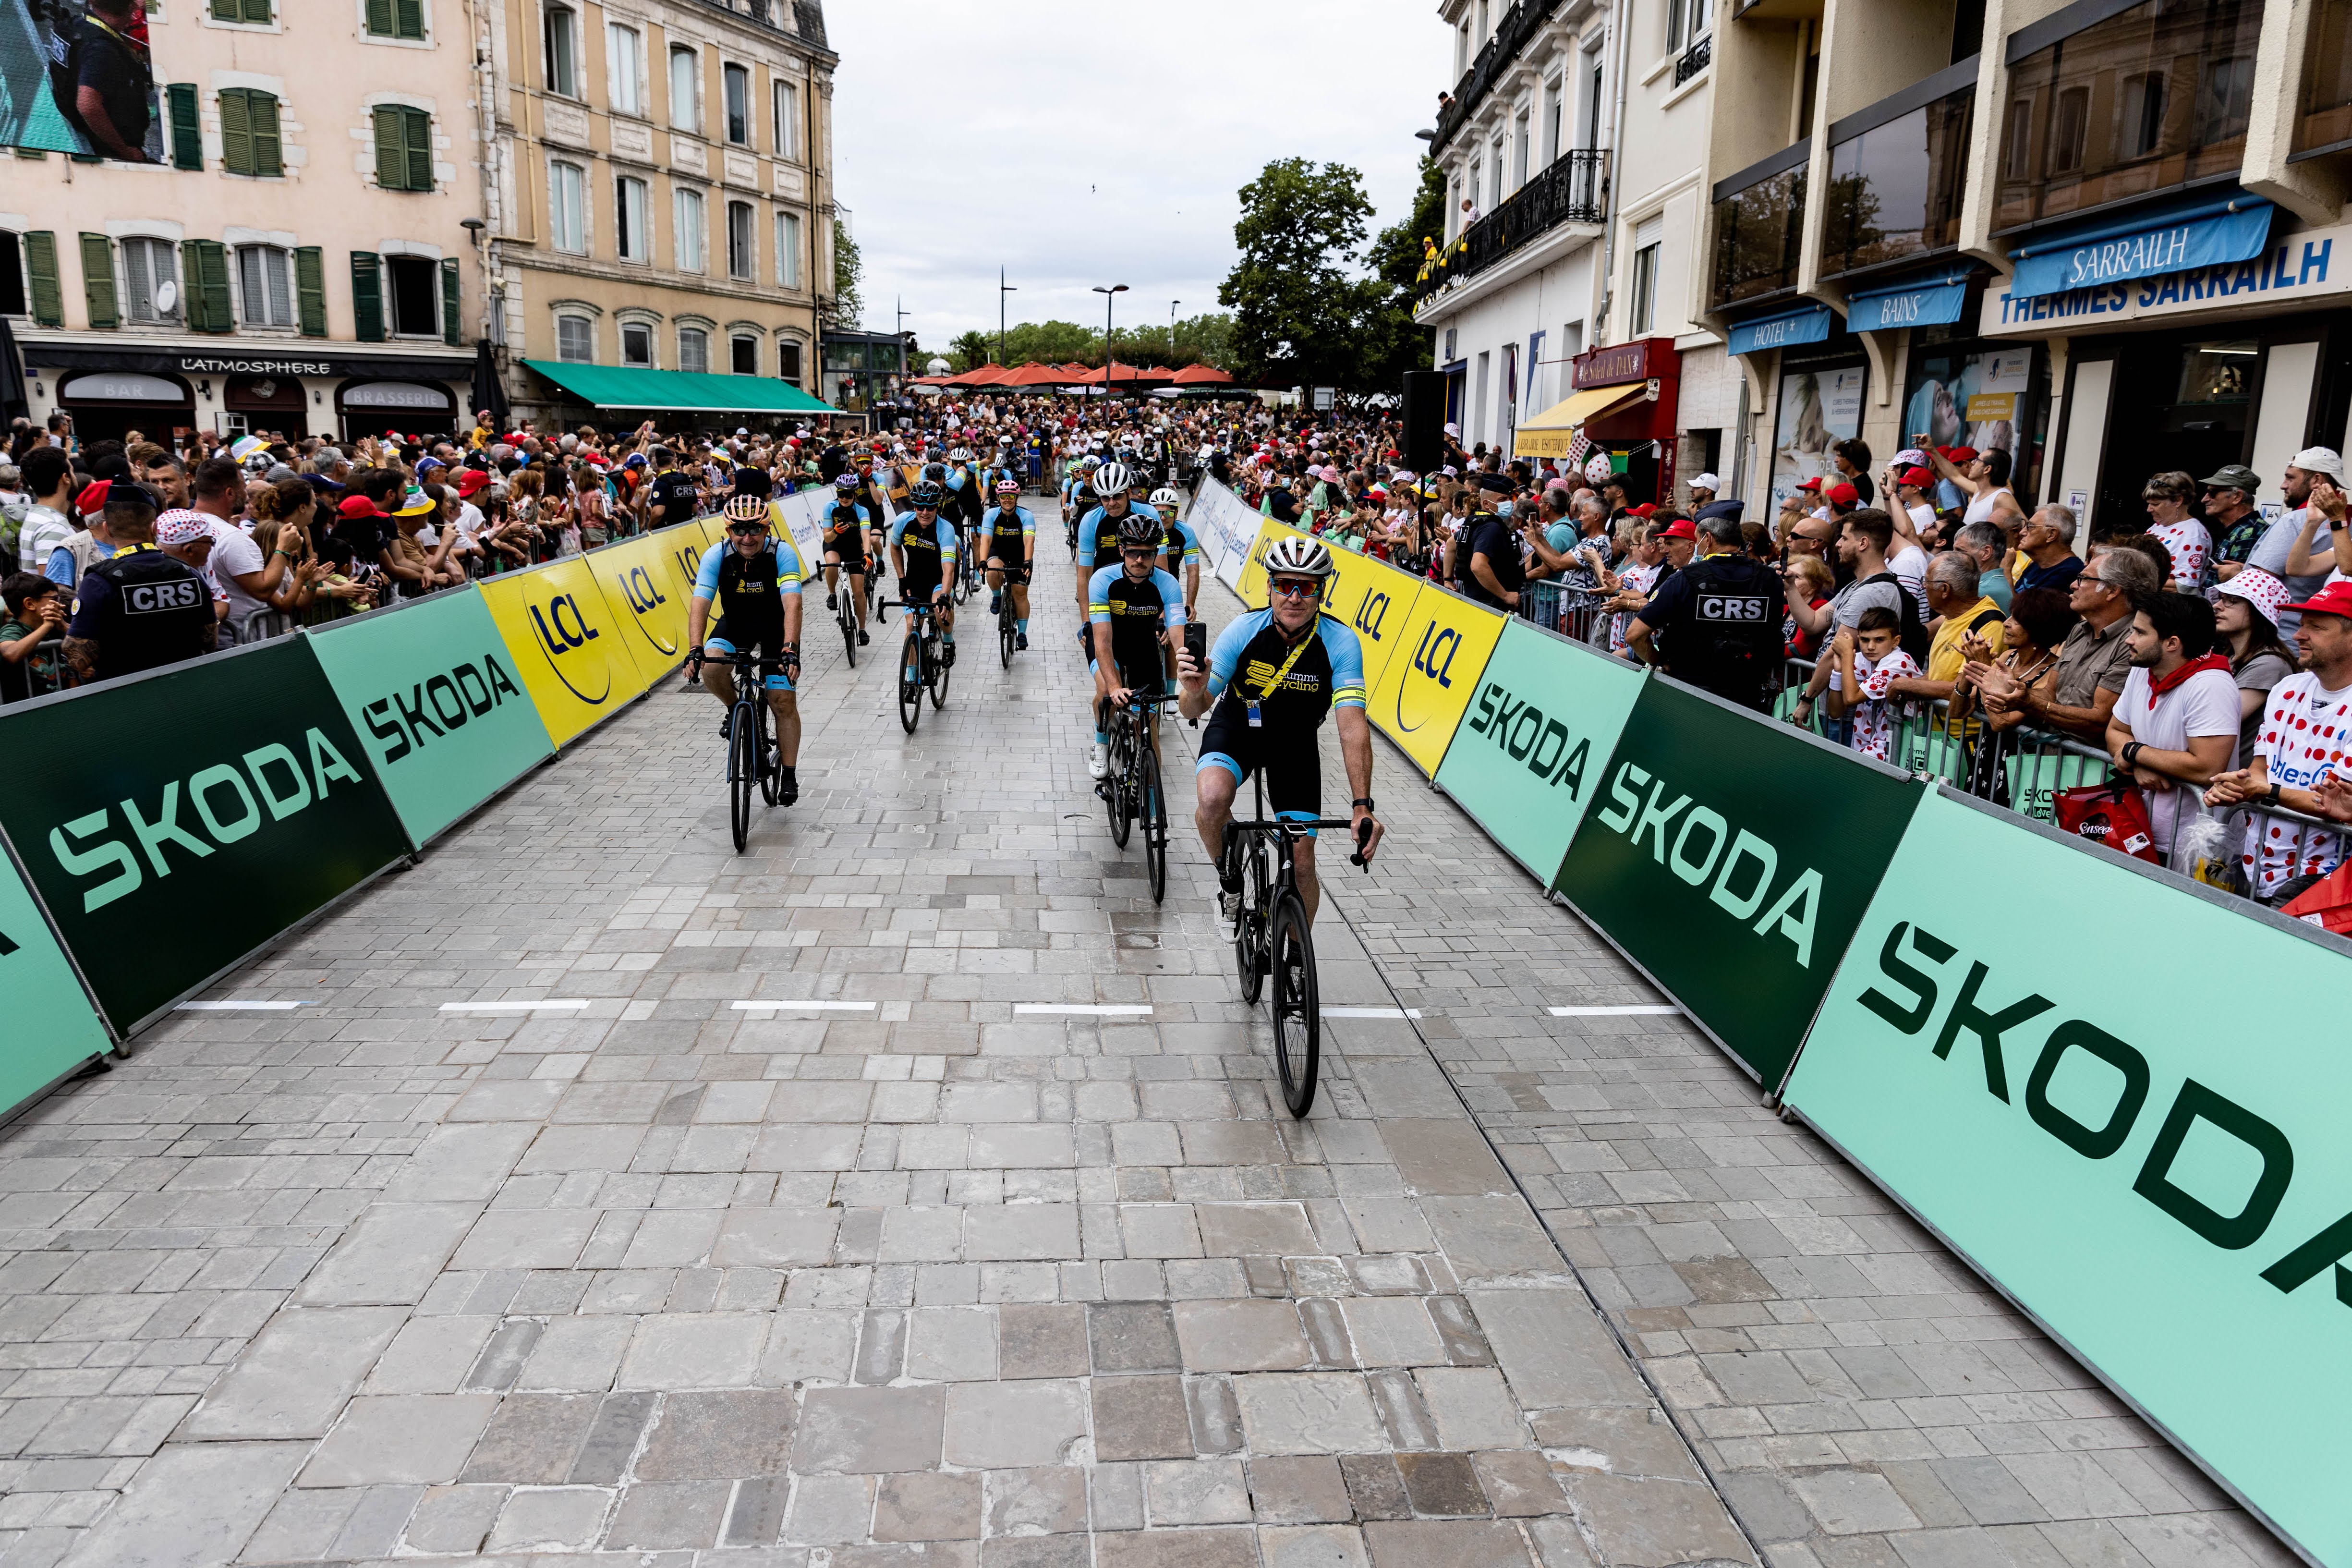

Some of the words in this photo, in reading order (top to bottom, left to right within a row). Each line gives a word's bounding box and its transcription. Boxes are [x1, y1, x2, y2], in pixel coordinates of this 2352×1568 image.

[2070, 228, 2189, 283] SARRAILH
[2000, 284, 2129, 324] THERMES
[2138, 238, 2332, 307] SARRAILH
[1881, 294, 1922, 324] BAINS
[1754, 321, 1785, 346] HOTEL
[181, 358, 331, 375] L'ATMOSPHERE
[1607, 359, 1614, 378] de
[1616, 354, 1634, 376] DAX
[105, 384, 144, 397] BAR
[353, 390, 438, 405] BRASSERIE
[1517, 438, 1539, 451] LIBRAIRIE
[676, 486, 695, 497] CRS
[917, 542, 936, 551] cycling
[132, 582, 196, 611] CRS
[618, 565, 666, 615] LCL
[1355, 587, 1391, 642] LCL
[1702, 598, 1763, 620] CRS
[530, 593, 599, 655] LCL
[1415, 620, 1463, 689] LCL
[2078, 822, 2113, 836] Senseo
